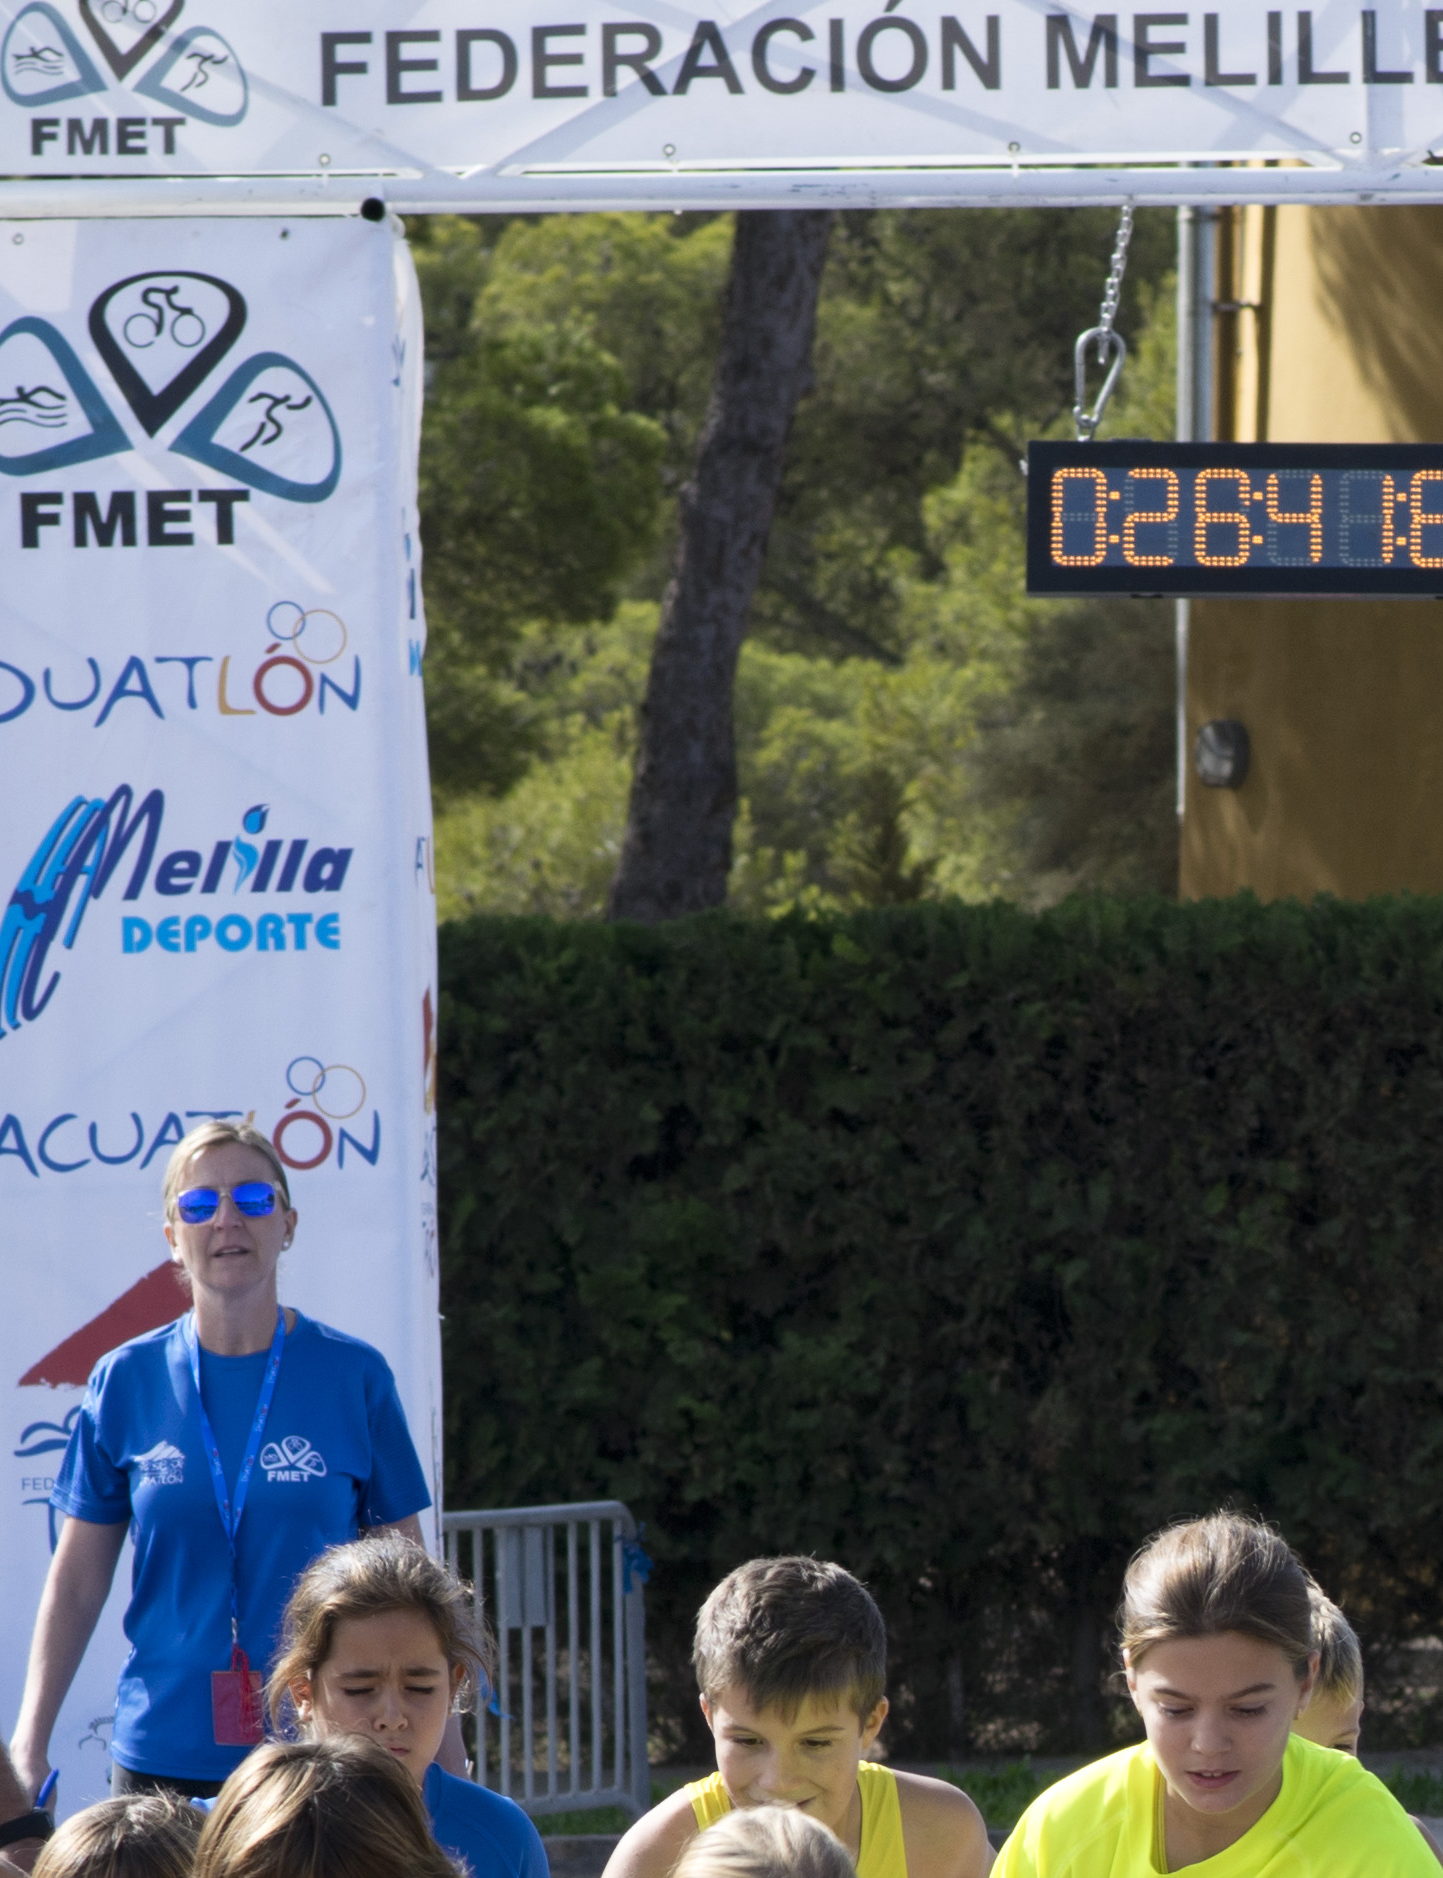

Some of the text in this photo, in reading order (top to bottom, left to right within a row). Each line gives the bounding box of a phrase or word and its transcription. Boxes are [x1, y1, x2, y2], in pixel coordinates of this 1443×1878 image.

[320, 0, 1000, 105] FEDERACIÓN
[30, 118, 187, 156] FMET
[19, 489, 250, 550] FMET
[122, 911, 341, 955] DEPORTE
[267, 1470, 311, 1482] FMET
